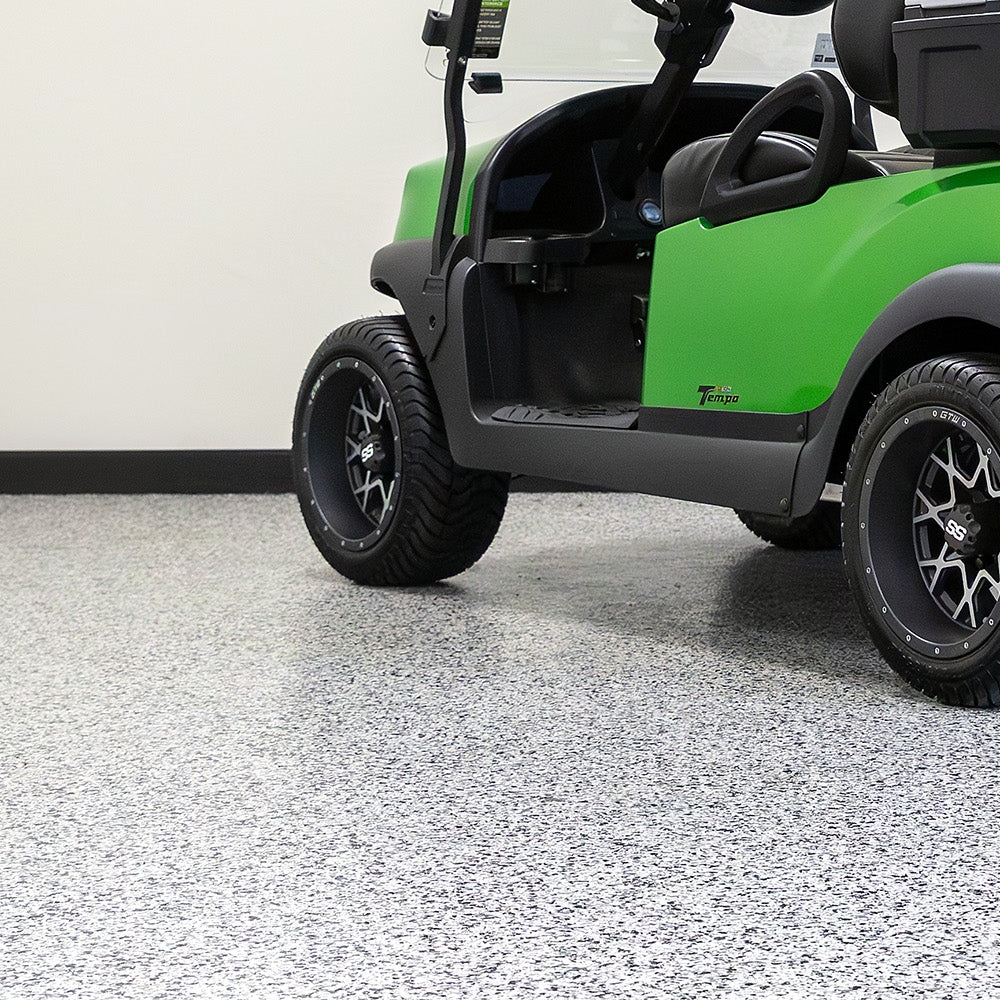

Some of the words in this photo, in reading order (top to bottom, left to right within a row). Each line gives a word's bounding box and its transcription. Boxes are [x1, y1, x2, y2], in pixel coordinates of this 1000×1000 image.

[698, 386, 739, 406] Tempo
[940, 410, 960, 424] GTW
[361, 443, 373, 462] SS
[946, 519, 967, 541] SS
